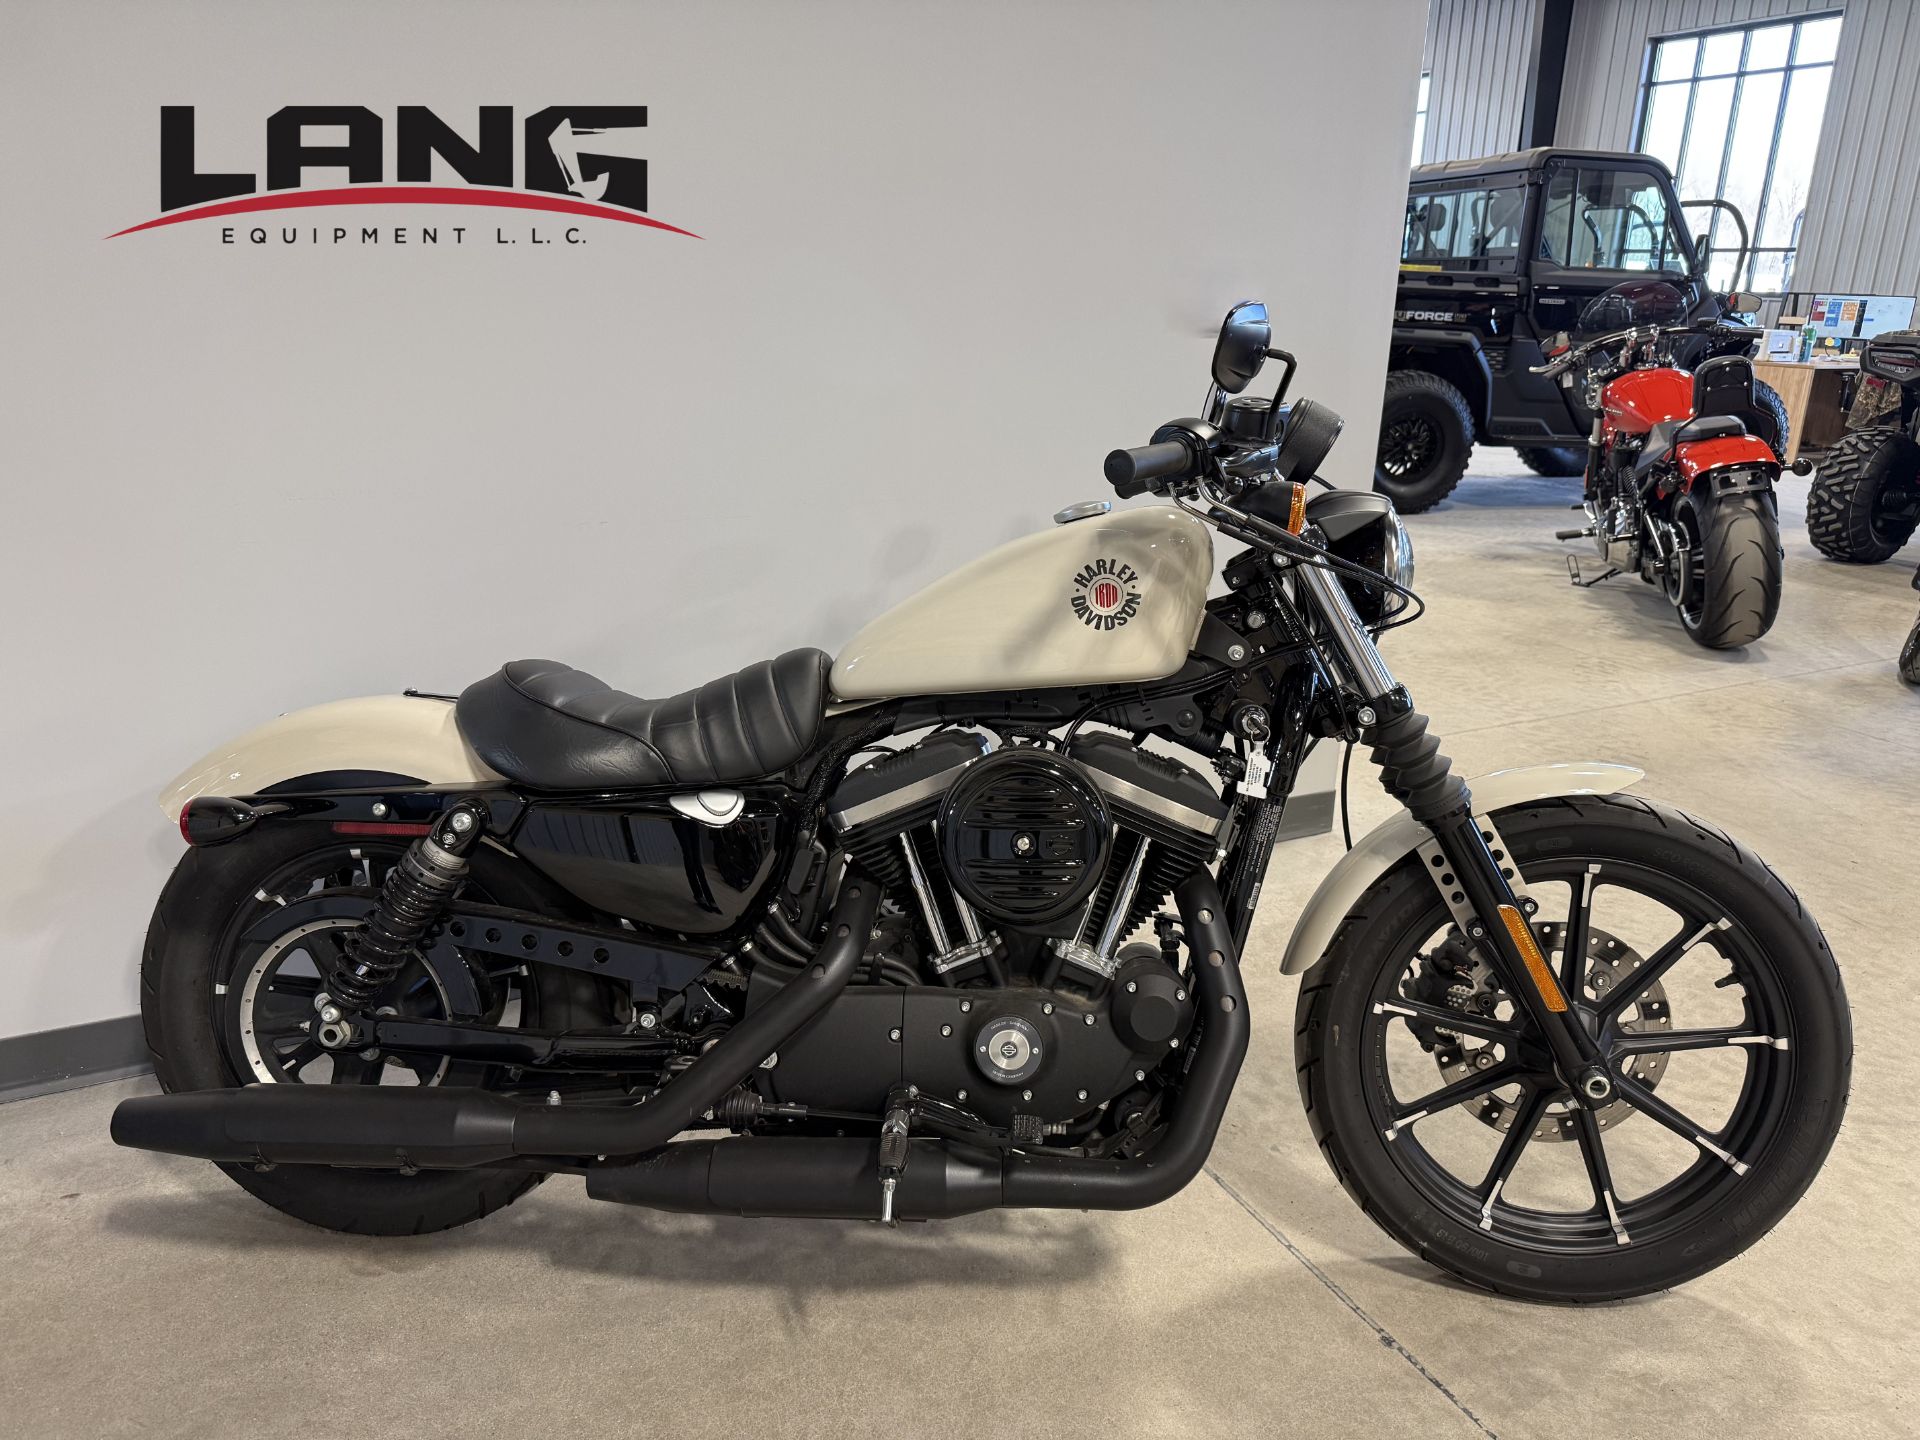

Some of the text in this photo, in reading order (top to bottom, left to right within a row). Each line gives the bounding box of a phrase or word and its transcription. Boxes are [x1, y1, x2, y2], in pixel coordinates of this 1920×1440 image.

[1073, 558, 1138, 589] HARLEY
[1070, 590, 1142, 631] DAVIDSON
[1095, 582, 1118, 608] IRON
